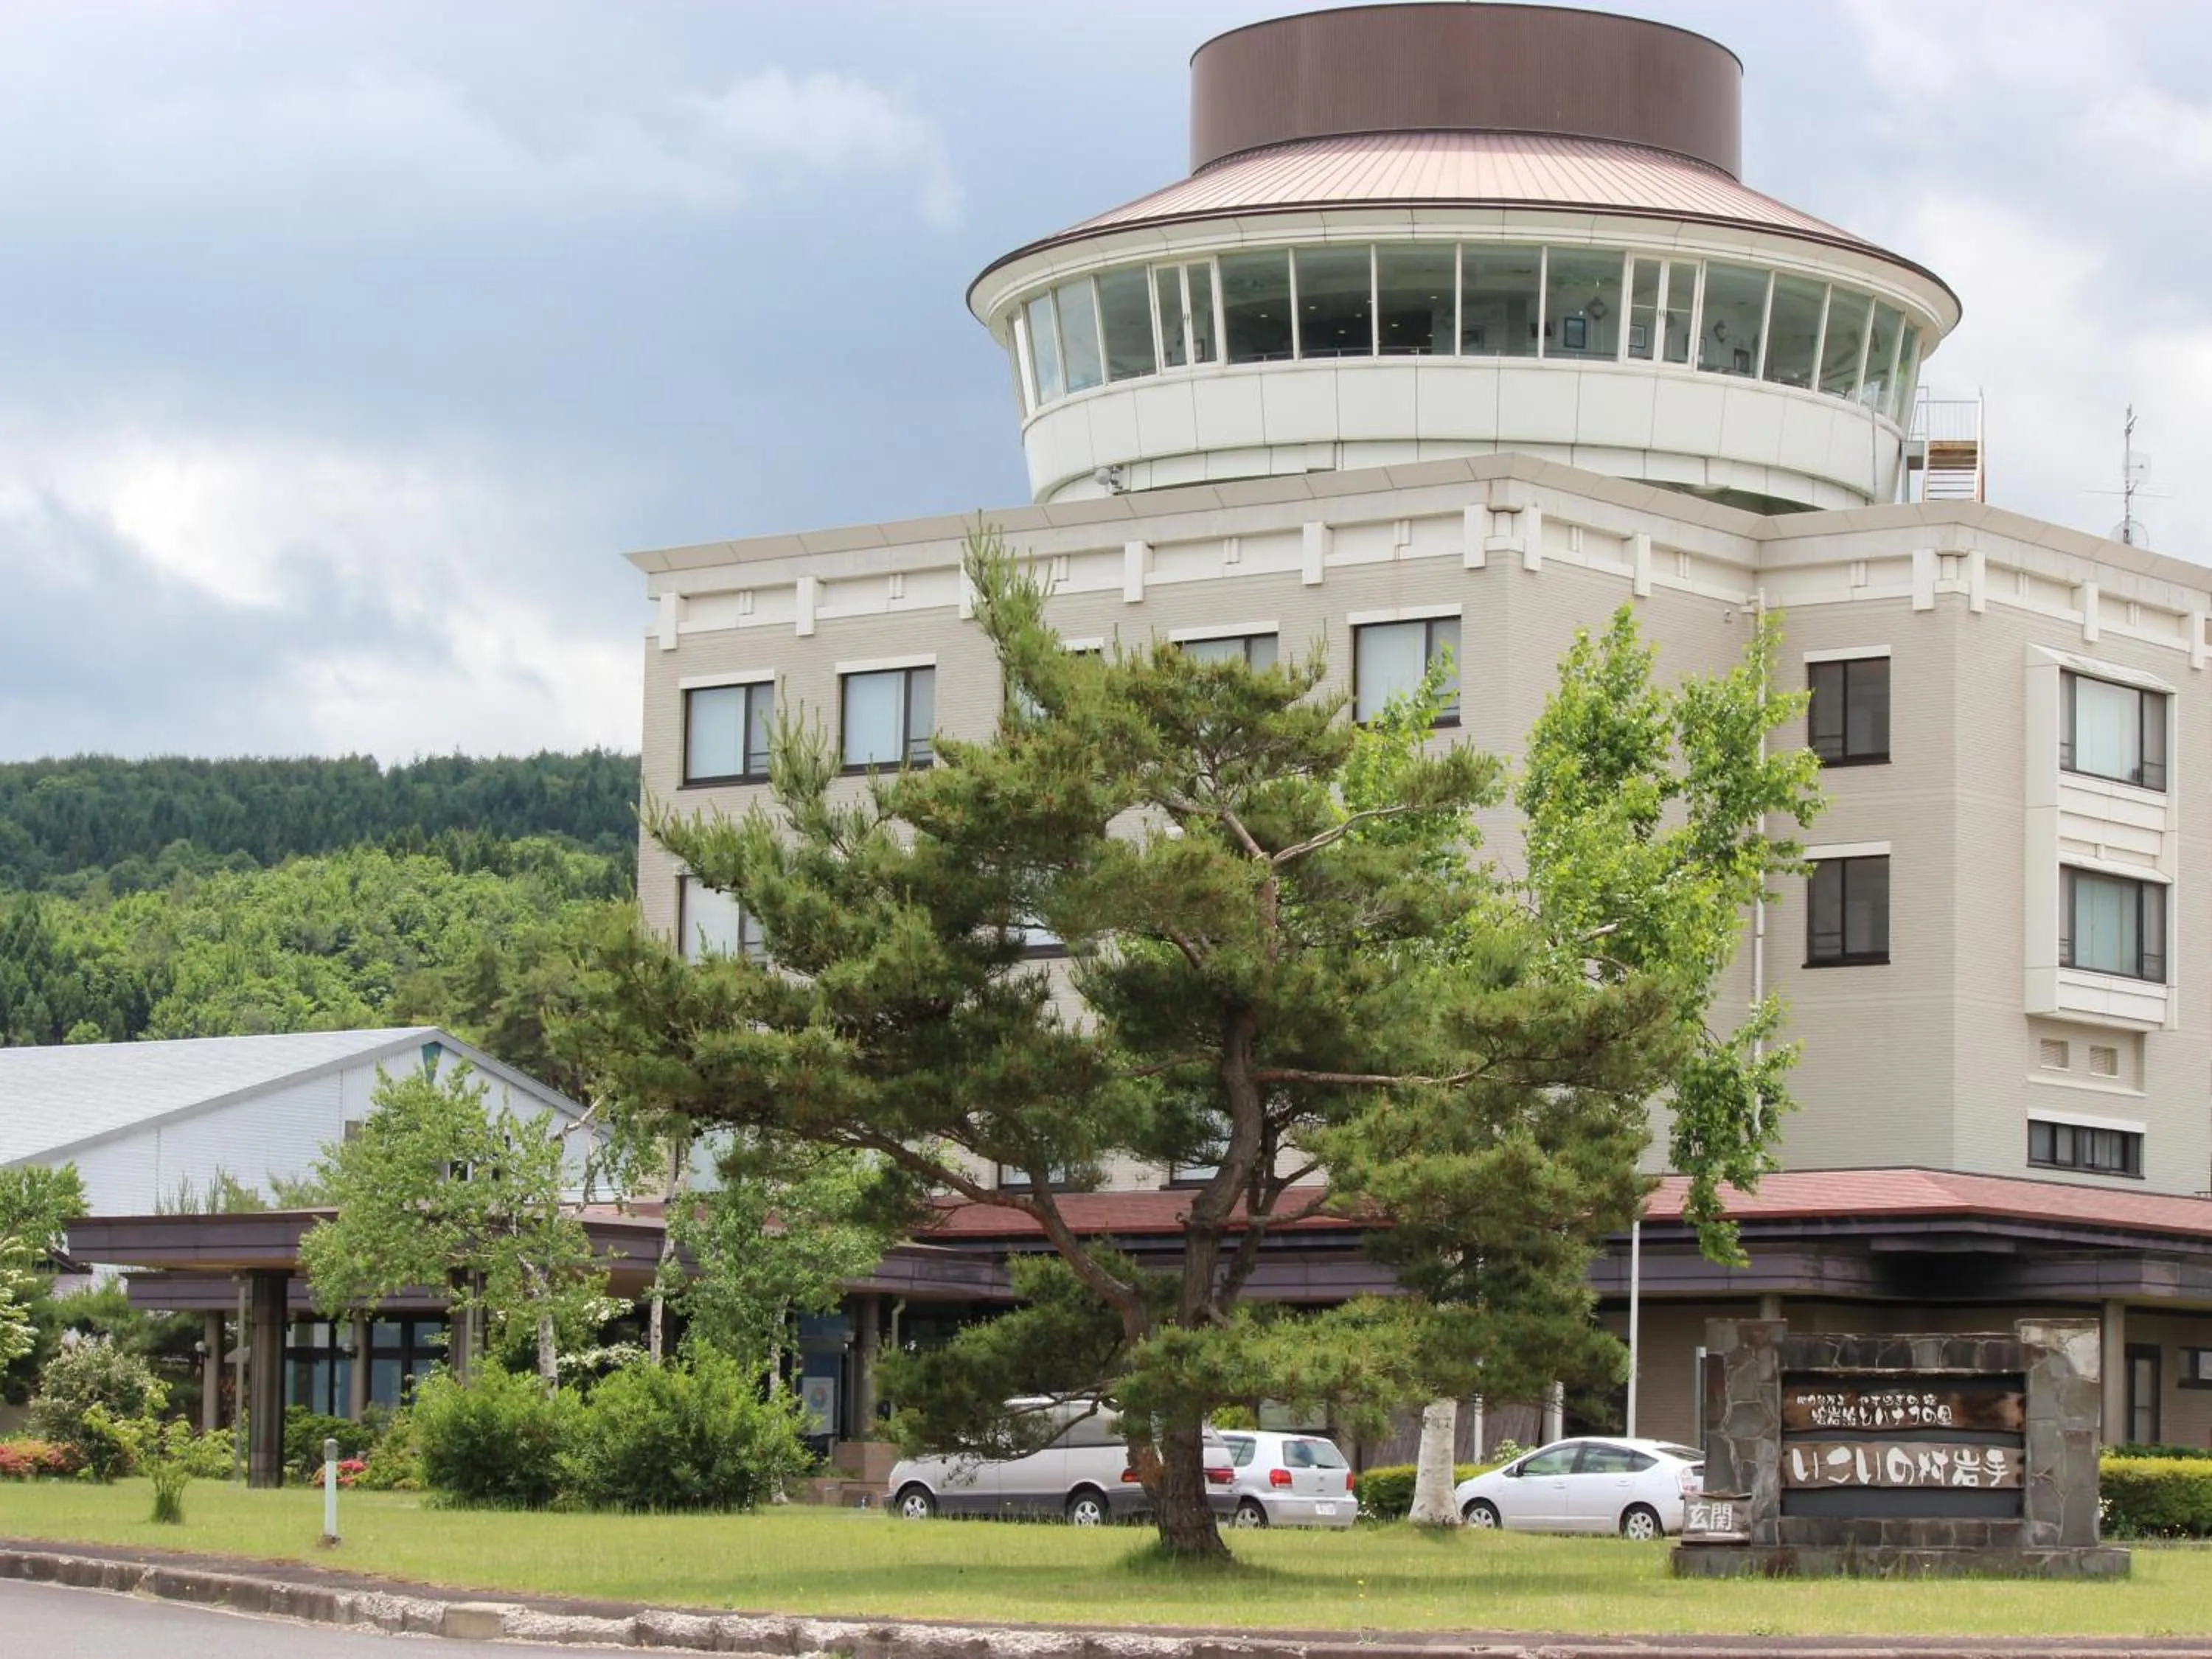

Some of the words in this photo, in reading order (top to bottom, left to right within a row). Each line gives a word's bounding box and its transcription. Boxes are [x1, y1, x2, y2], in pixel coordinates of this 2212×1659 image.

[1792, 1446, 2010, 1488] いこいの村岩手
[1688, 1502, 1733, 1531] 玄関
